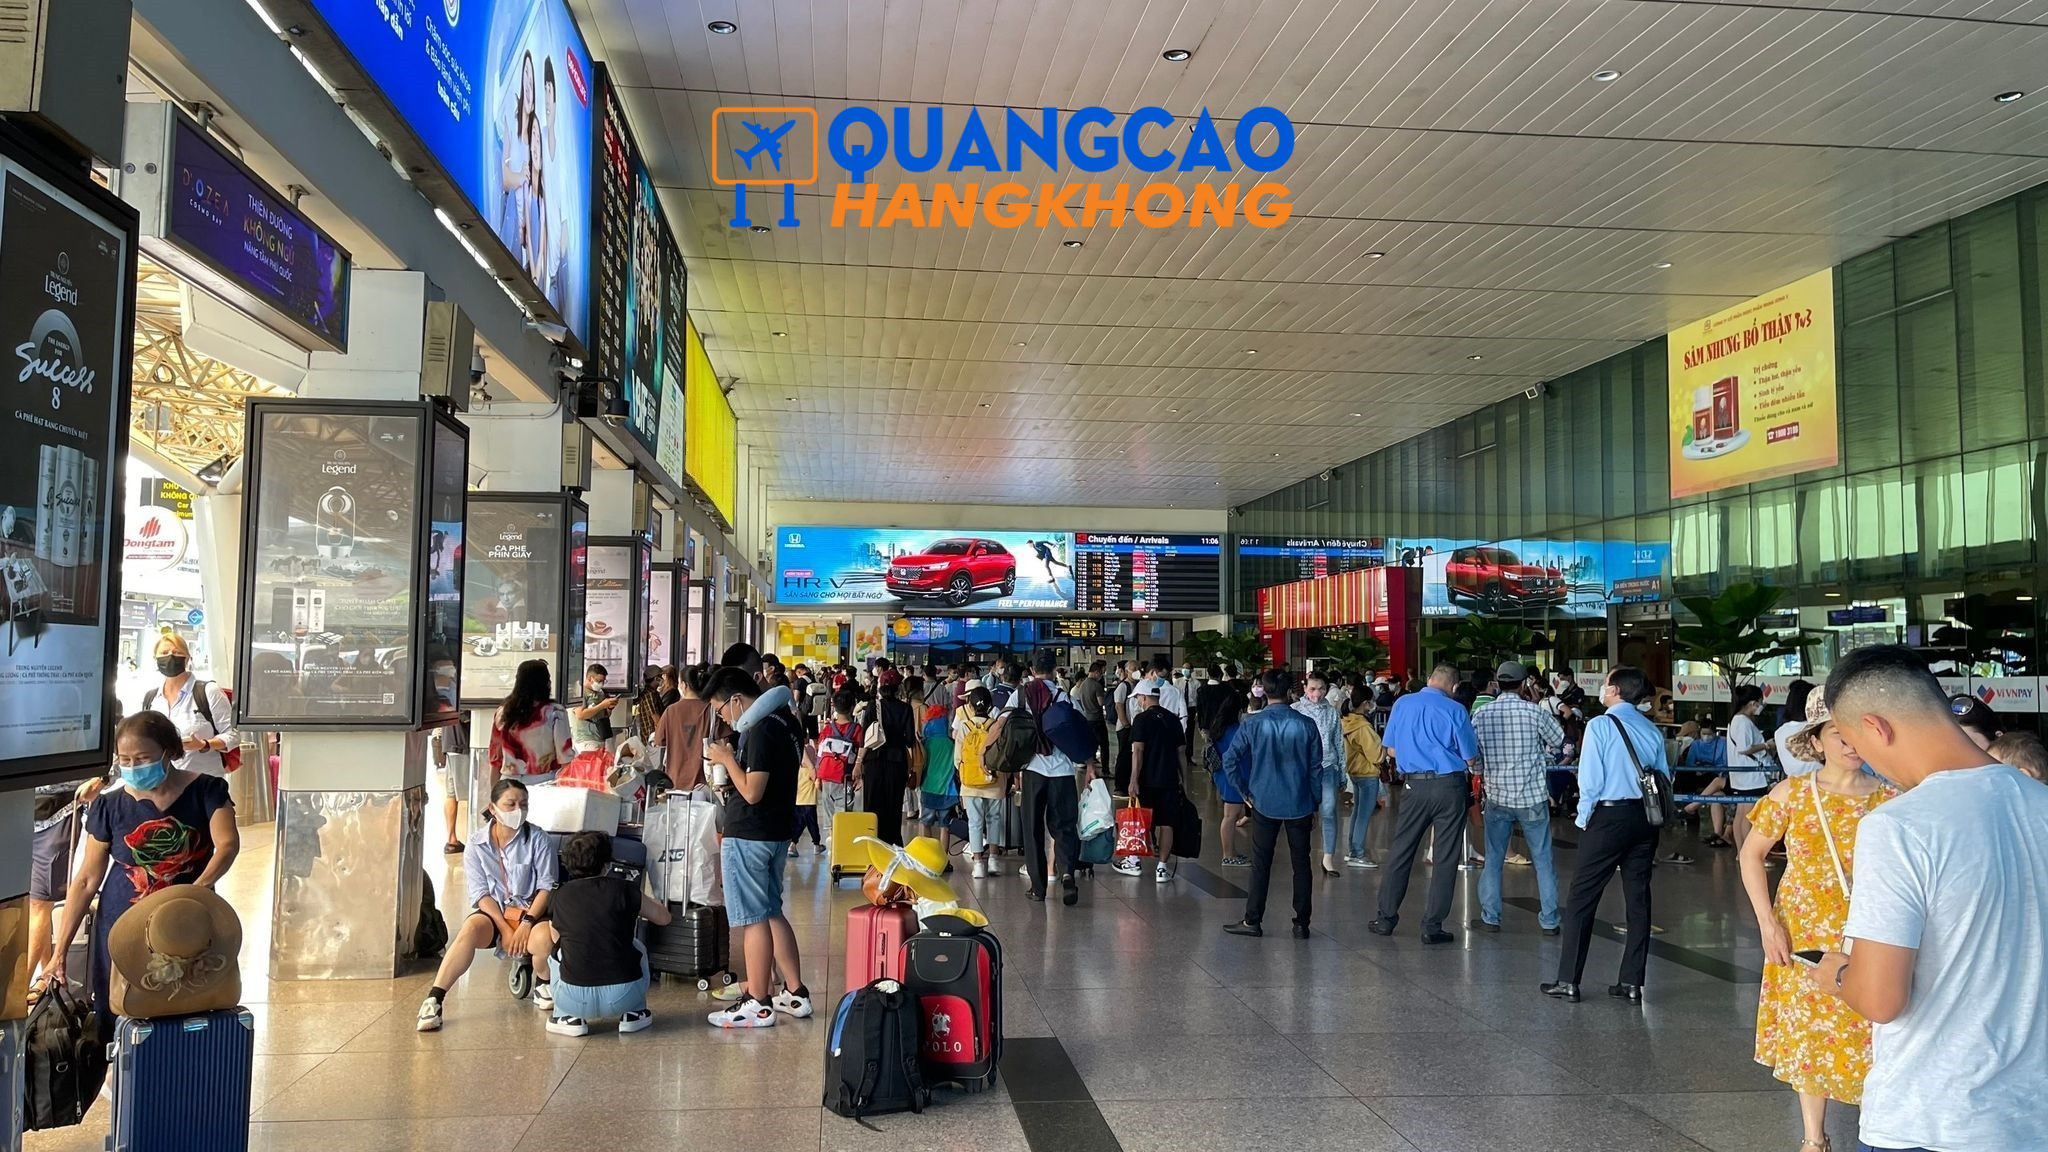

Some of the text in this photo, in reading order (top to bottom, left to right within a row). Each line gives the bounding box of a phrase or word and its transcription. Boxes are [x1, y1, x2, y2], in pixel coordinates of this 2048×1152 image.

[248, 194, 293, 240] THIÊN ĐƯỜNG
[242, 214, 295, 266] KHÔNG NGỦ
[45, 274, 78, 307] Legend
[1684, 345, 1705, 371] SÂM
[1706, 333, 1741, 363] NHUNG
[1743, 317, 1760, 349] BỔ
[1761, 312, 1793, 345] THẬN
[15, 341, 95, 395] Success
[51, 386, 61, 410] 8
[321, 463, 357, 476] Legend
[160, 491, 188, 500] KHÔNG
[176, 501, 189, 509] Car
[499, 533, 522, 542] Legend
[1087, 535, 1117, 544] Chuyến
[1117, 535, 1134, 544] đến
[1139, 536, 1170, 545] Arrivals
[1201, 537, 1219, 545] 11:06
[784, 577, 847, 589] HR-V
[1651, 579, 1660, 591] A1
[836, 592, 852, 600] MỌI
[1018, 599, 1069, 609] PERFORMANCE
[1055, 645, 1123, 656] F G H
[925, 1040, 962, 1053] OLO
